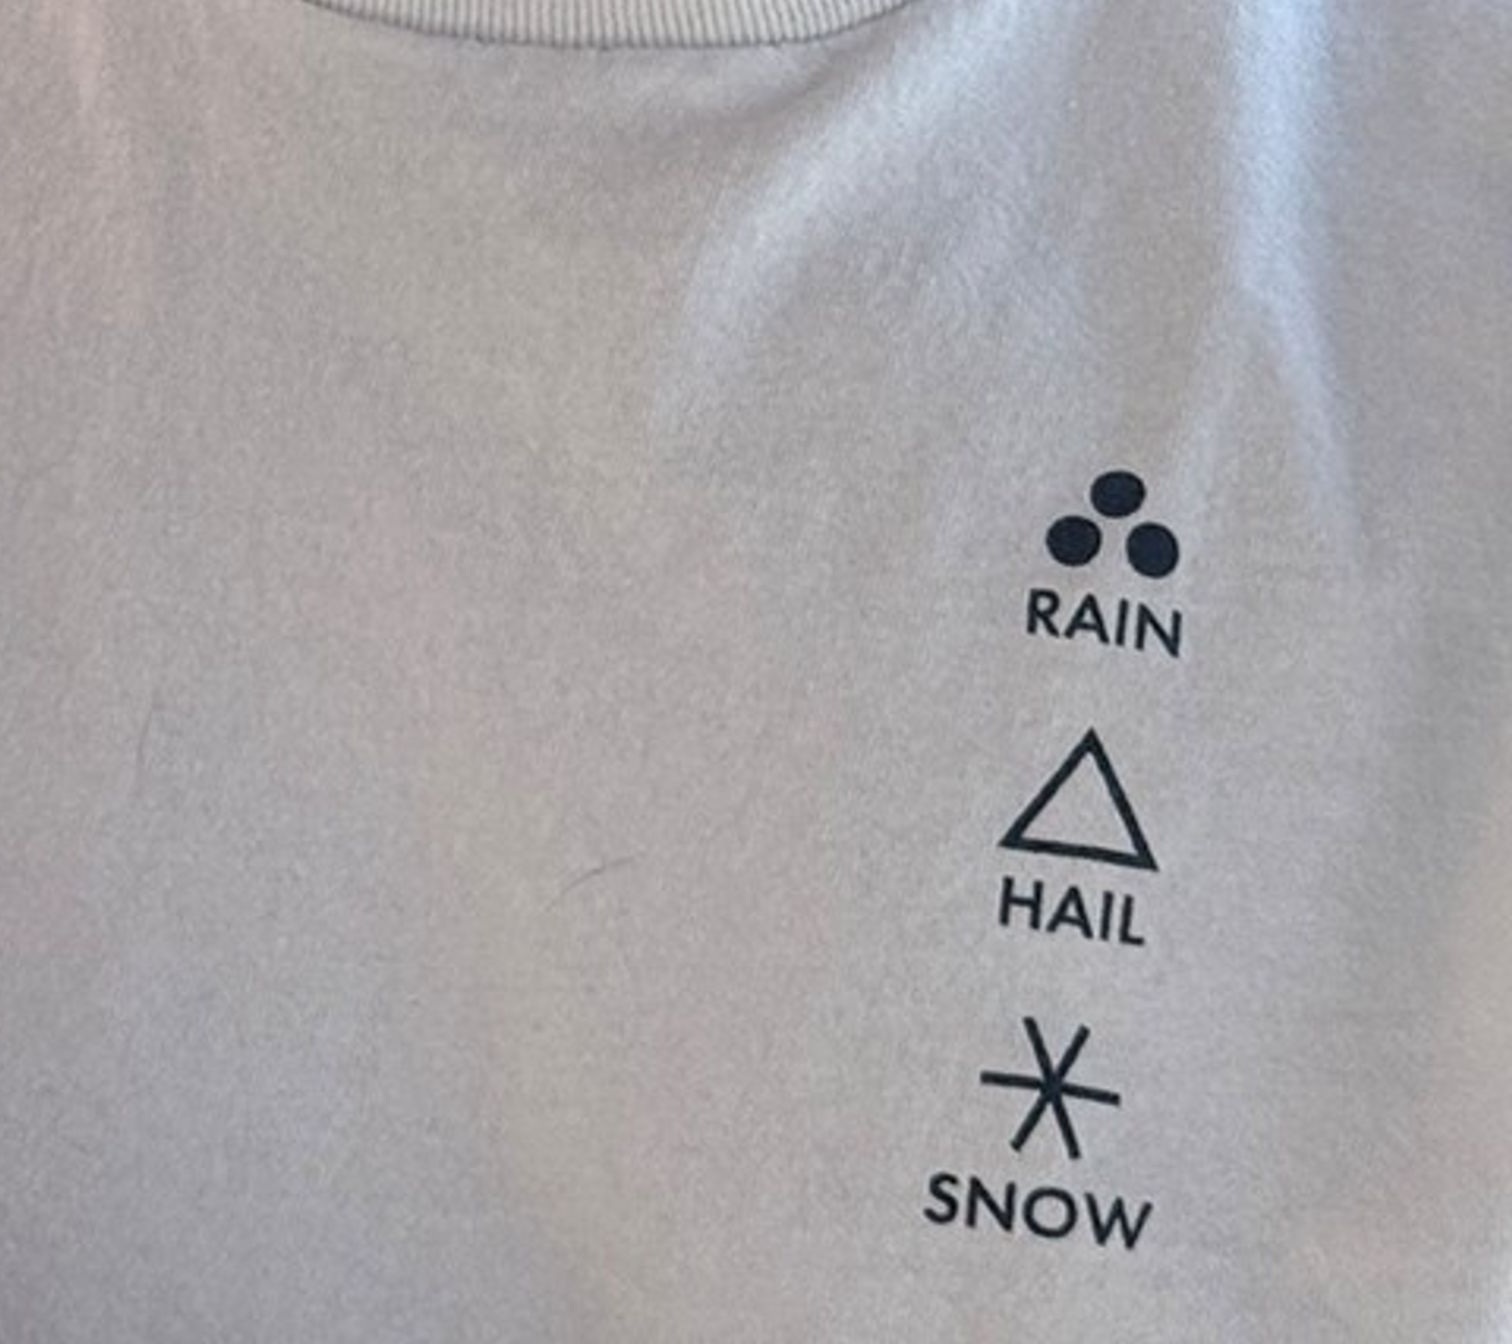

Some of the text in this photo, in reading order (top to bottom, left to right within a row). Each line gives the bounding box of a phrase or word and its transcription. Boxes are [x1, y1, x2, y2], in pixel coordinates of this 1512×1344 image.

[1025, 588, 1183, 658] RAIN
[998, 876, 1147, 946] HAIL
[923, 1172, 1153, 1250] SNOW
